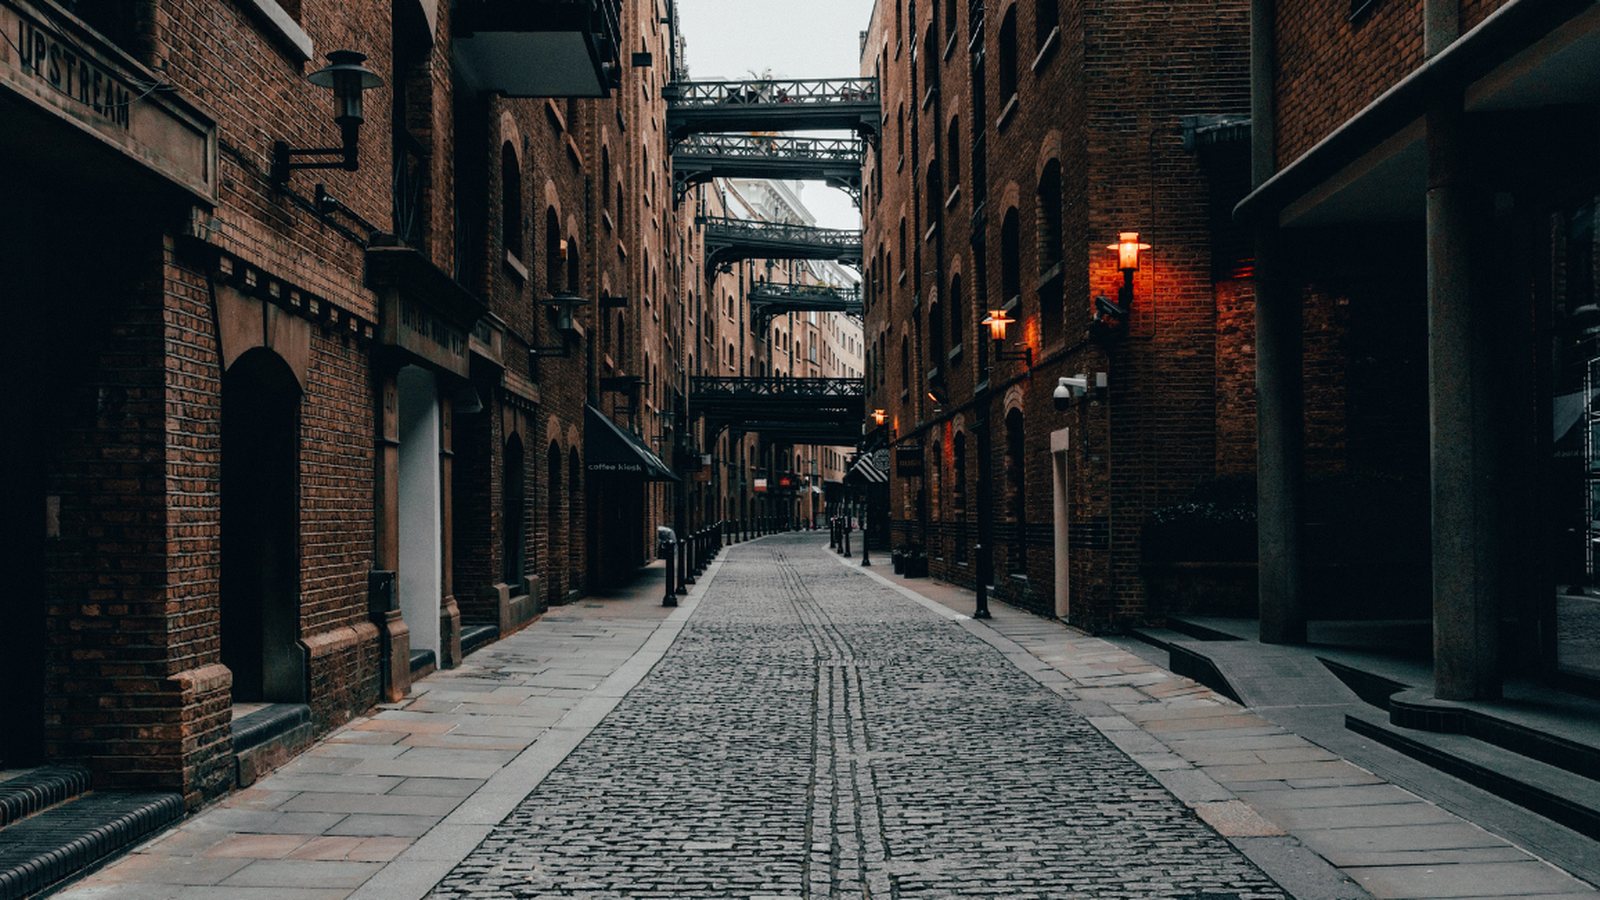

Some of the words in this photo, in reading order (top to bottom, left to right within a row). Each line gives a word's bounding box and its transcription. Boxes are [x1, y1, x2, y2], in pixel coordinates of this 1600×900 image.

[18, 20, 129, 130] UPSTREAM
[587, 463, 616, 471] coffee
[618, 463, 642, 472] kiosk
